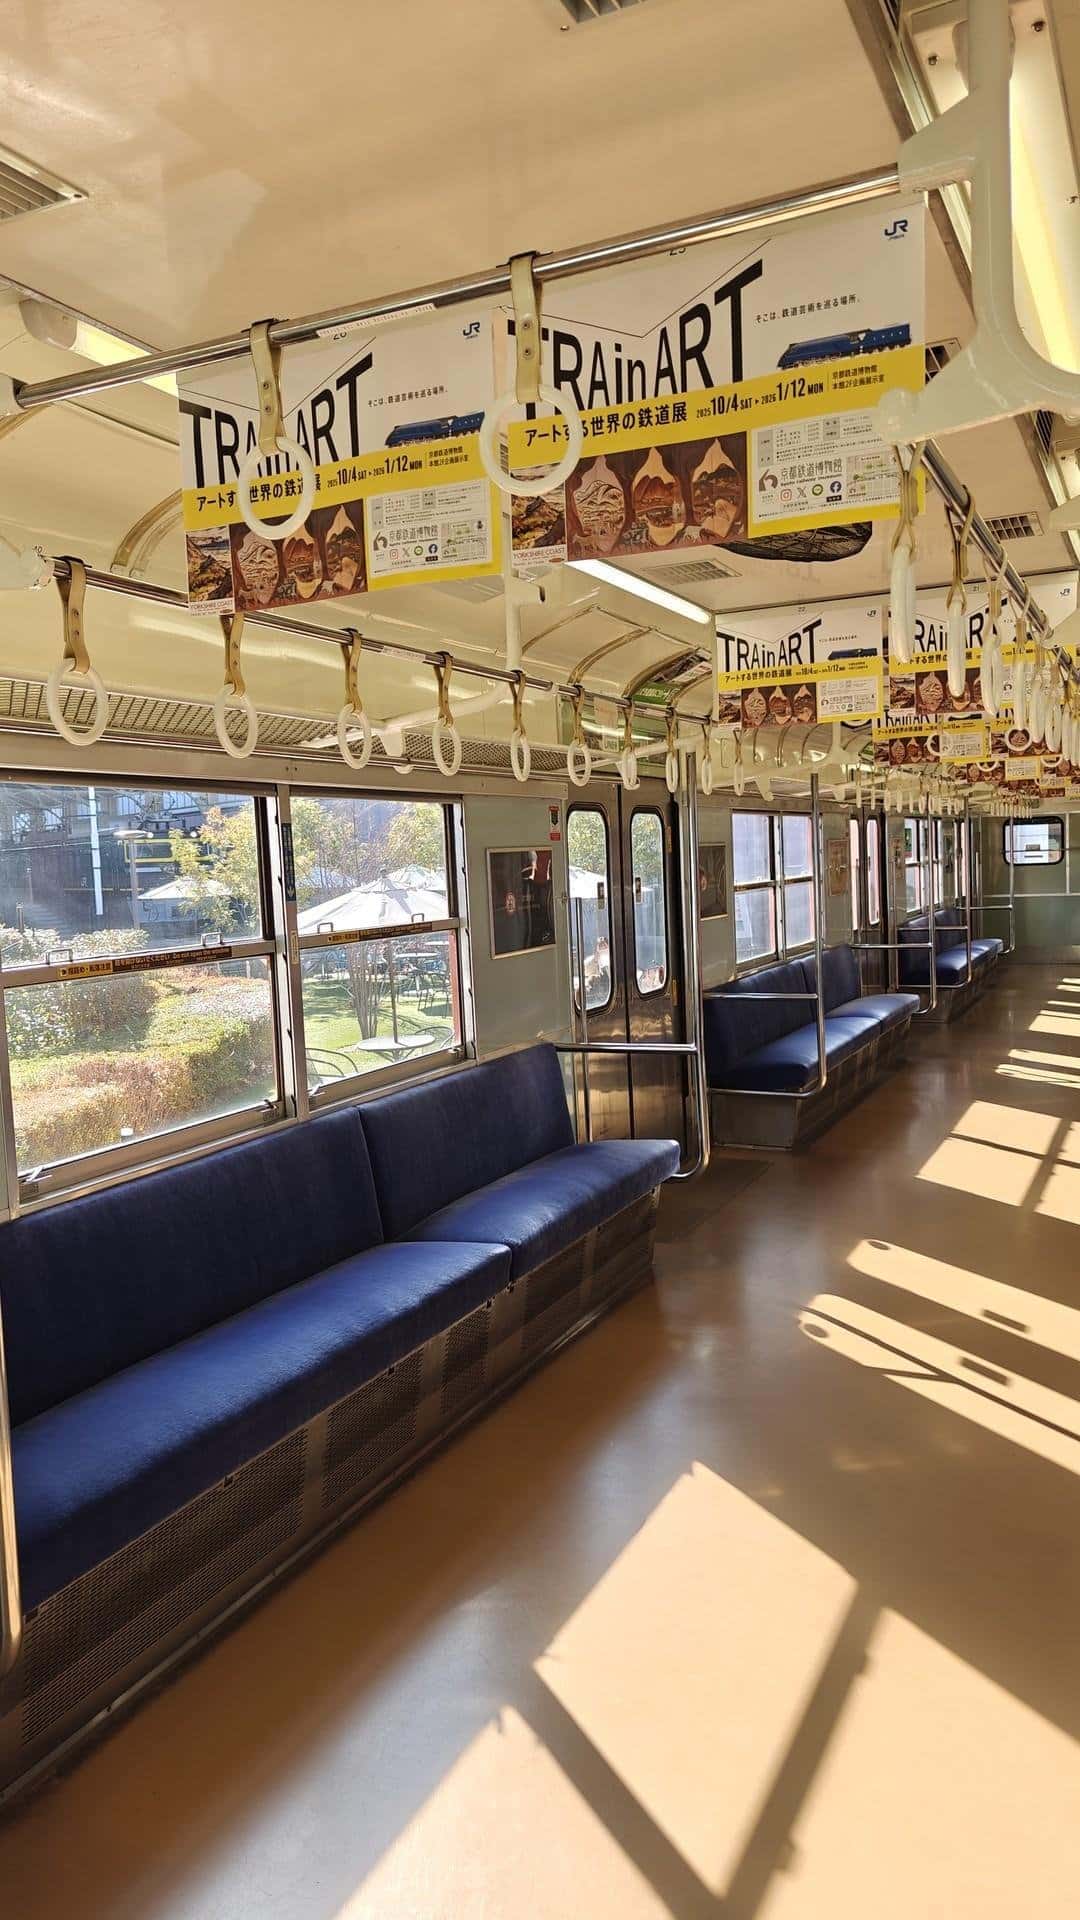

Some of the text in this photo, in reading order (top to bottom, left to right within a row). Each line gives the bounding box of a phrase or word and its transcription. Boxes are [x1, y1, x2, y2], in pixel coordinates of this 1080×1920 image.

[885, 219, 908, 236] JR
[463, 322, 480, 336] JR
[711, 393, 739, 416] 10/4
[776, 378, 806, 401] 1/12
[807, 383, 824, 395] MON
[385, 455, 408, 474] 1/12
